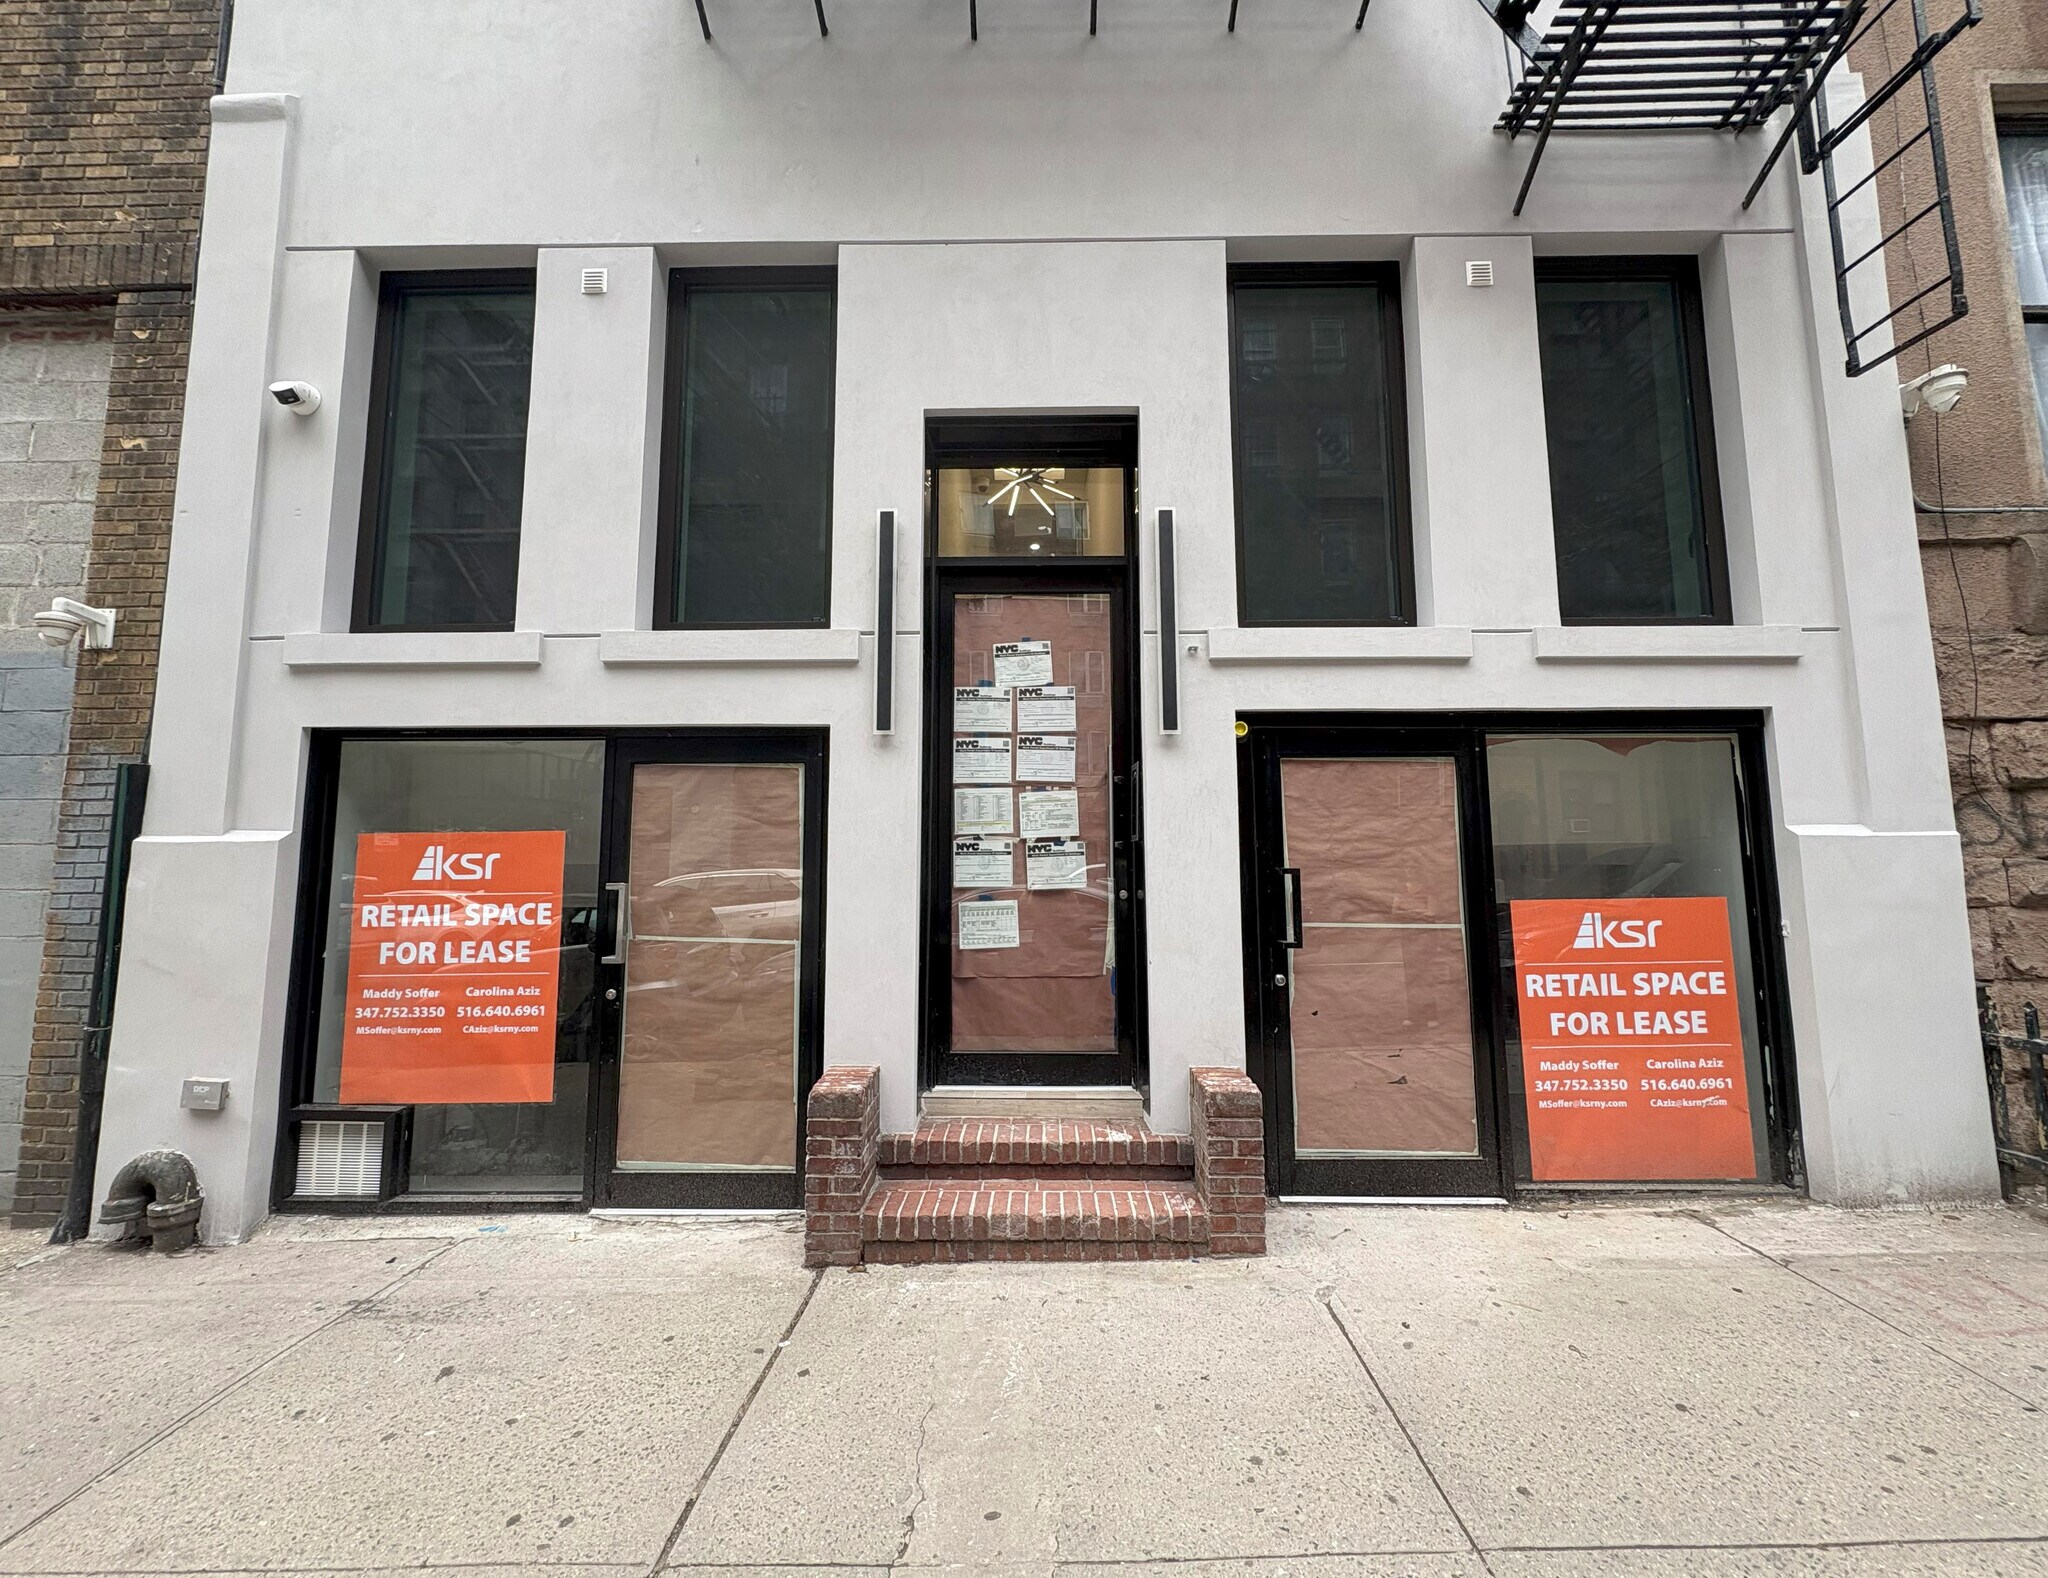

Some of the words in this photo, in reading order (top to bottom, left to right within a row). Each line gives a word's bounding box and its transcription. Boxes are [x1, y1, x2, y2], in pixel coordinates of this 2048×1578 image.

[996, 645, 1018, 653] NYC
[956, 689, 979, 697] NYC
[1019, 688, 1042, 696] NYC
[956, 740, 979, 748] NYC
[1019, 737, 1042, 745] NYC
[1028, 844, 1051, 852] NYC
[362, 905, 457, 927] RETAIL
[464, 903, 552, 926] SPACE
[380, 942, 436, 964] FOR
[444, 941, 531, 963] LEASE
[1526, 974, 1626, 997] RETAIL
[1633, 972, 1726, 995] SPACE
[362, 988, 403, 1001] Maddy
[404, 987, 441, 998] Soffer
[465, 986, 515, 997] Carolina
[516, 985, 541, 996] Aziz
[354, 1006, 446, 1019] 347.752.3350
[456, 1005, 545, 1018] 516.640.6961
[1551, 1012, 1609, 1035] FOR
[1617, 1011, 1707, 1034] LEASE
[356, 1025, 442, 1036] MSoffer@ksrny.com
[462, 1024, 539, 1035] CAziz@ksrny.com
[1540, 1060, 1580, 1073] Maddy
[1581, 1059, 1619, 1070] Soffer
[1646, 1058, 1697, 1069] Carolina
[1698, 1057, 1724, 1068] Aziz
[1534, 1078, 1628, 1092] 347.752.3350
[1640, 1077, 1733, 1091] 516.640.6961
[1538, 1098, 1628, 1110] MSoffer@ksrny.com
